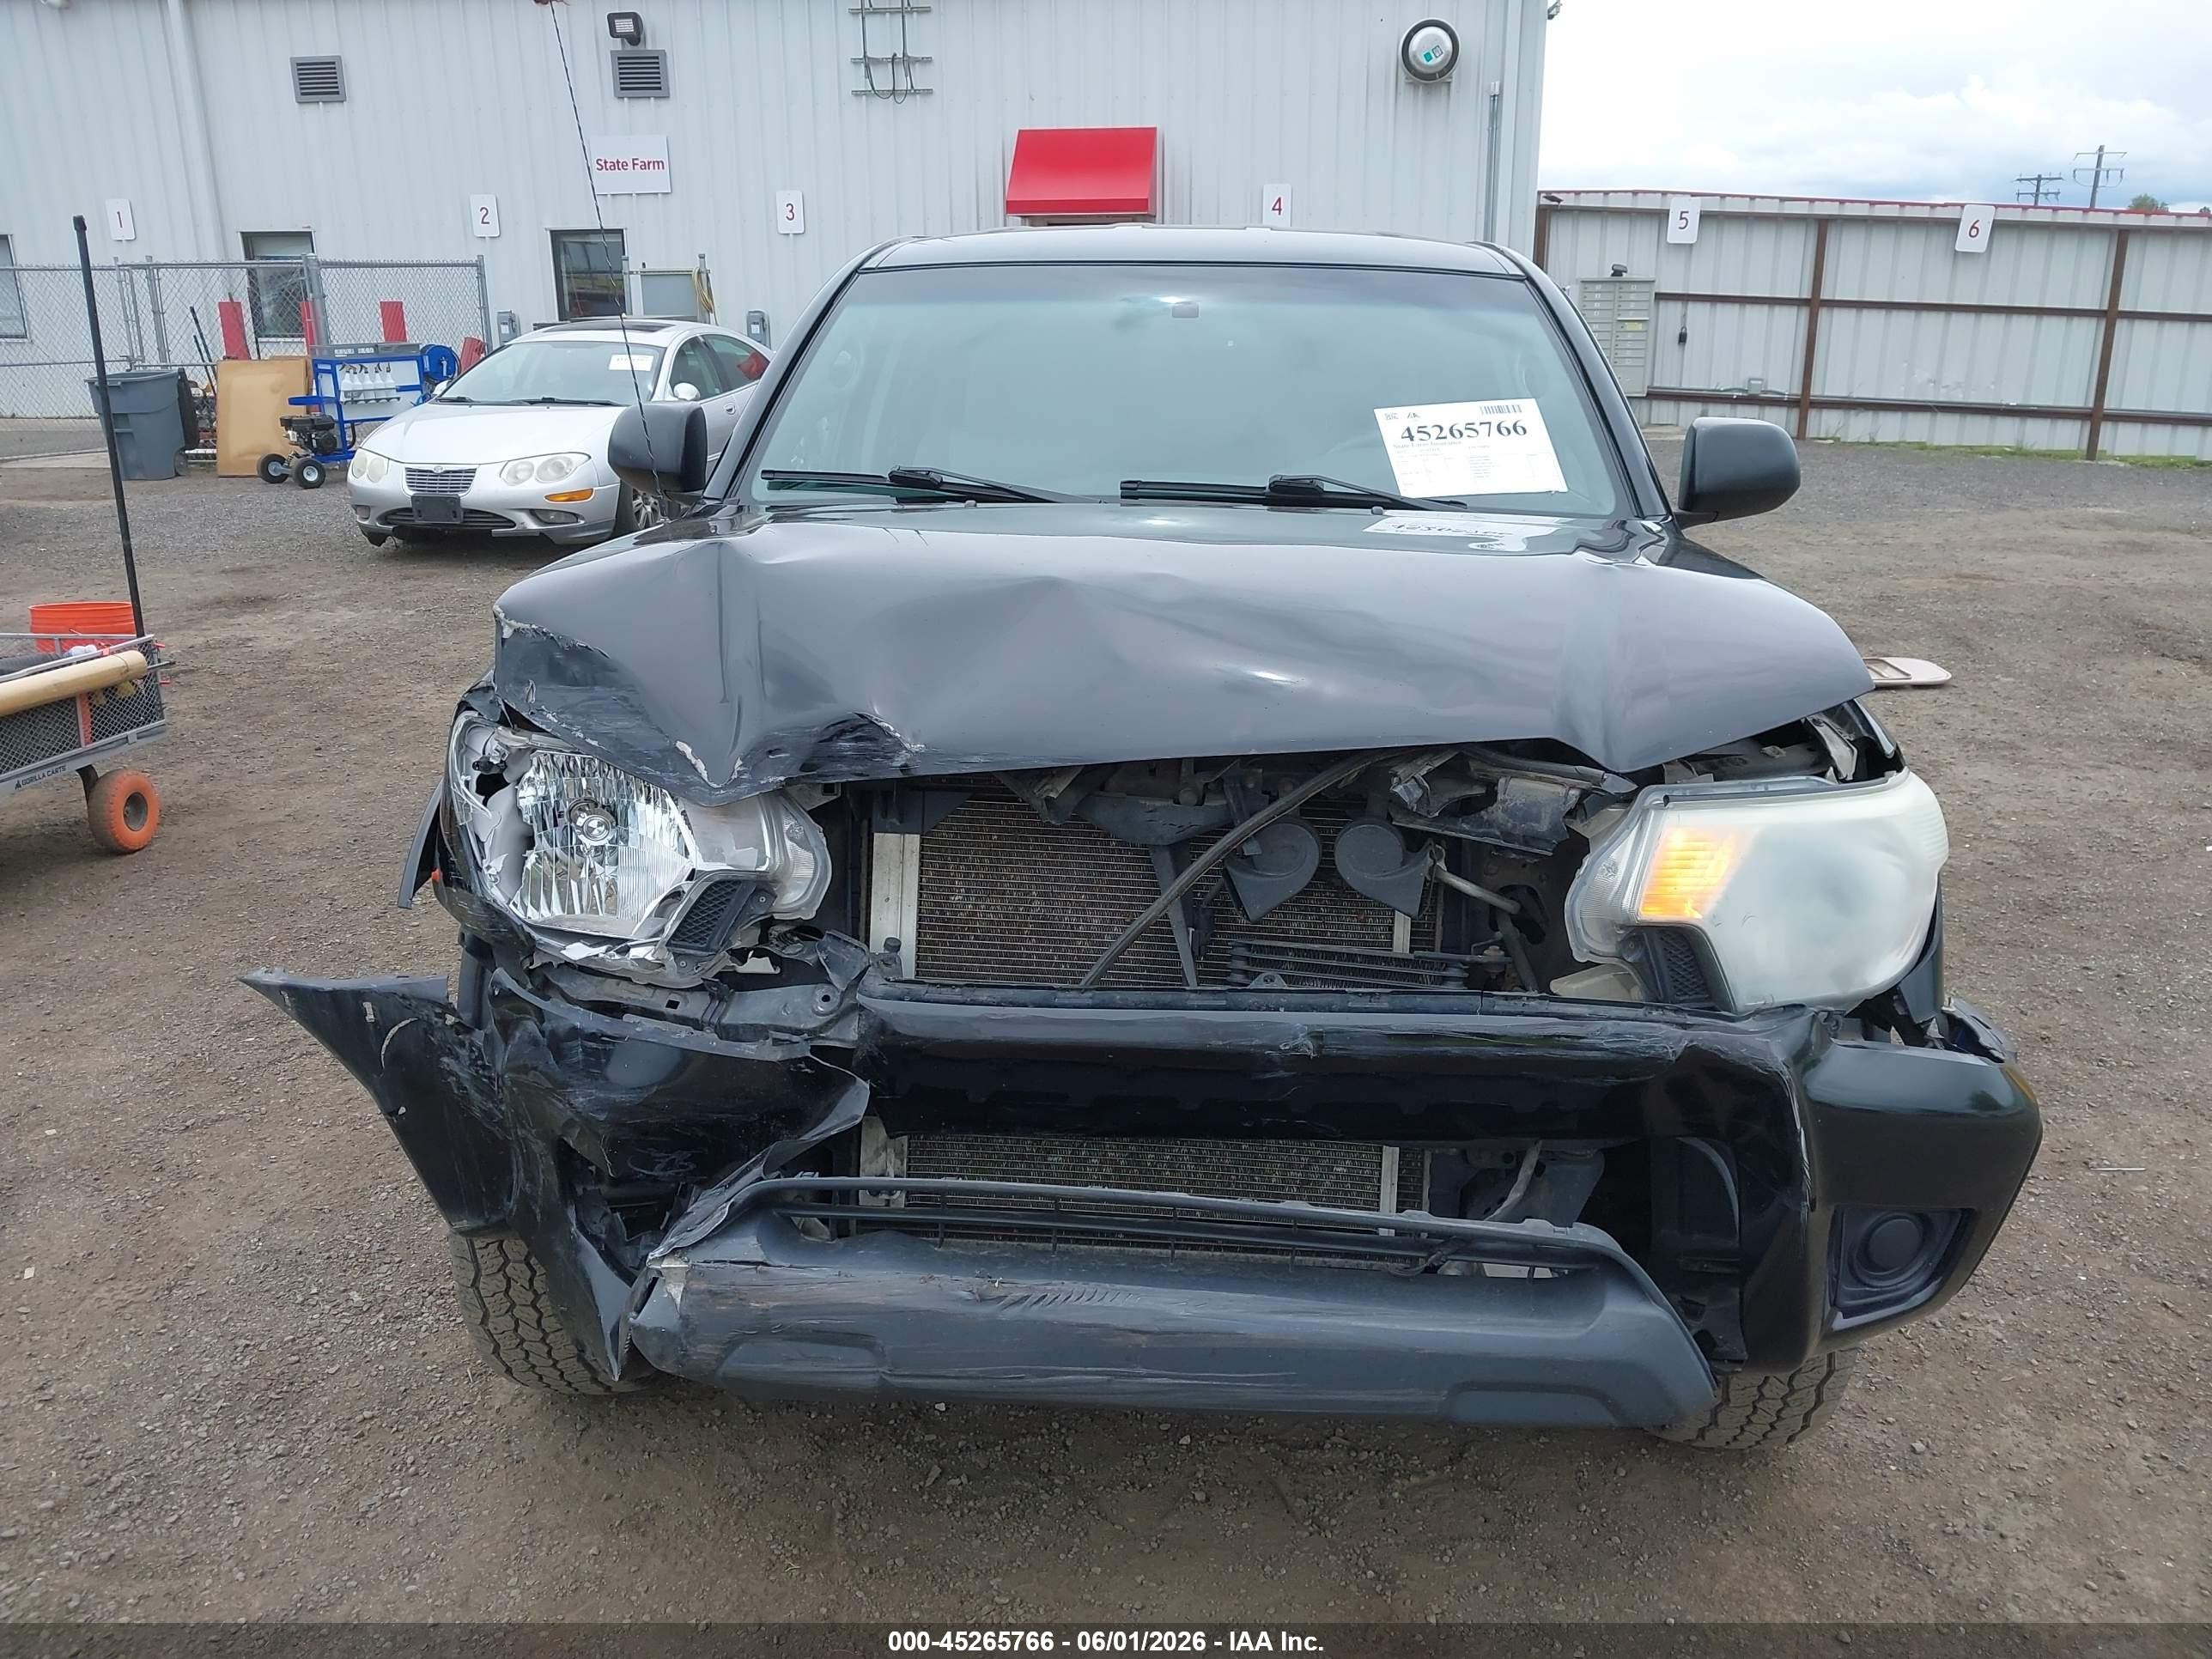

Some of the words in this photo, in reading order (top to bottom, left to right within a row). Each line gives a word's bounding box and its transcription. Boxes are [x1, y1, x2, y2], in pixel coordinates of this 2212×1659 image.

[595, 158, 629, 172] State
[632, 157, 665, 171] Farm
[479, 206, 490, 225] 2
[785, 203, 795, 222] 3
[1271, 196, 1283, 216] 4
[116, 210, 124, 228] 1
[1678, 210, 1690, 230] 5
[1968, 219, 1980, 239] 6
[1401, 419, 1528, 441] 45265766
[22, 773, 46, 786] GORILLA
